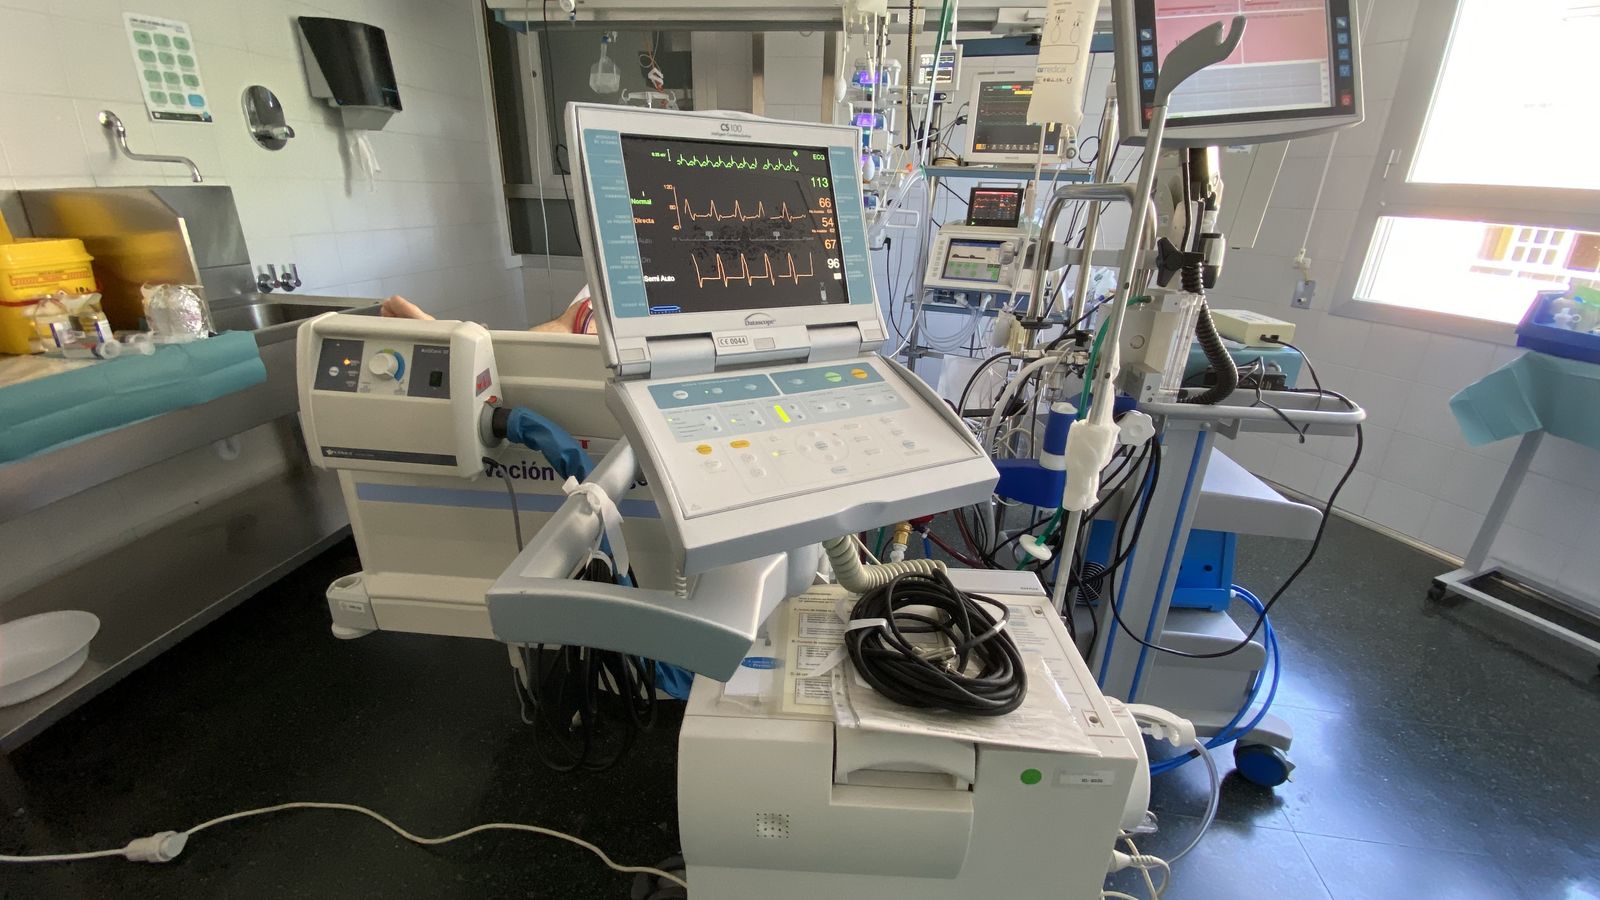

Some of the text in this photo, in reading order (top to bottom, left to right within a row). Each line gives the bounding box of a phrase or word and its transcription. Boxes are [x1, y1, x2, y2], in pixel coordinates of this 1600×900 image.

[812, 153, 825, 161] ECG
[810, 176, 829, 188] 113
[818, 197, 832, 208] 66
[821, 217, 835, 228] 54
[824, 238, 837, 250] 67
[826, 258, 840, 269] 96
[643, 274, 660, 283] Semi
[660, 274, 676, 282] Auto
[729, 336, 746, 345] 0044
